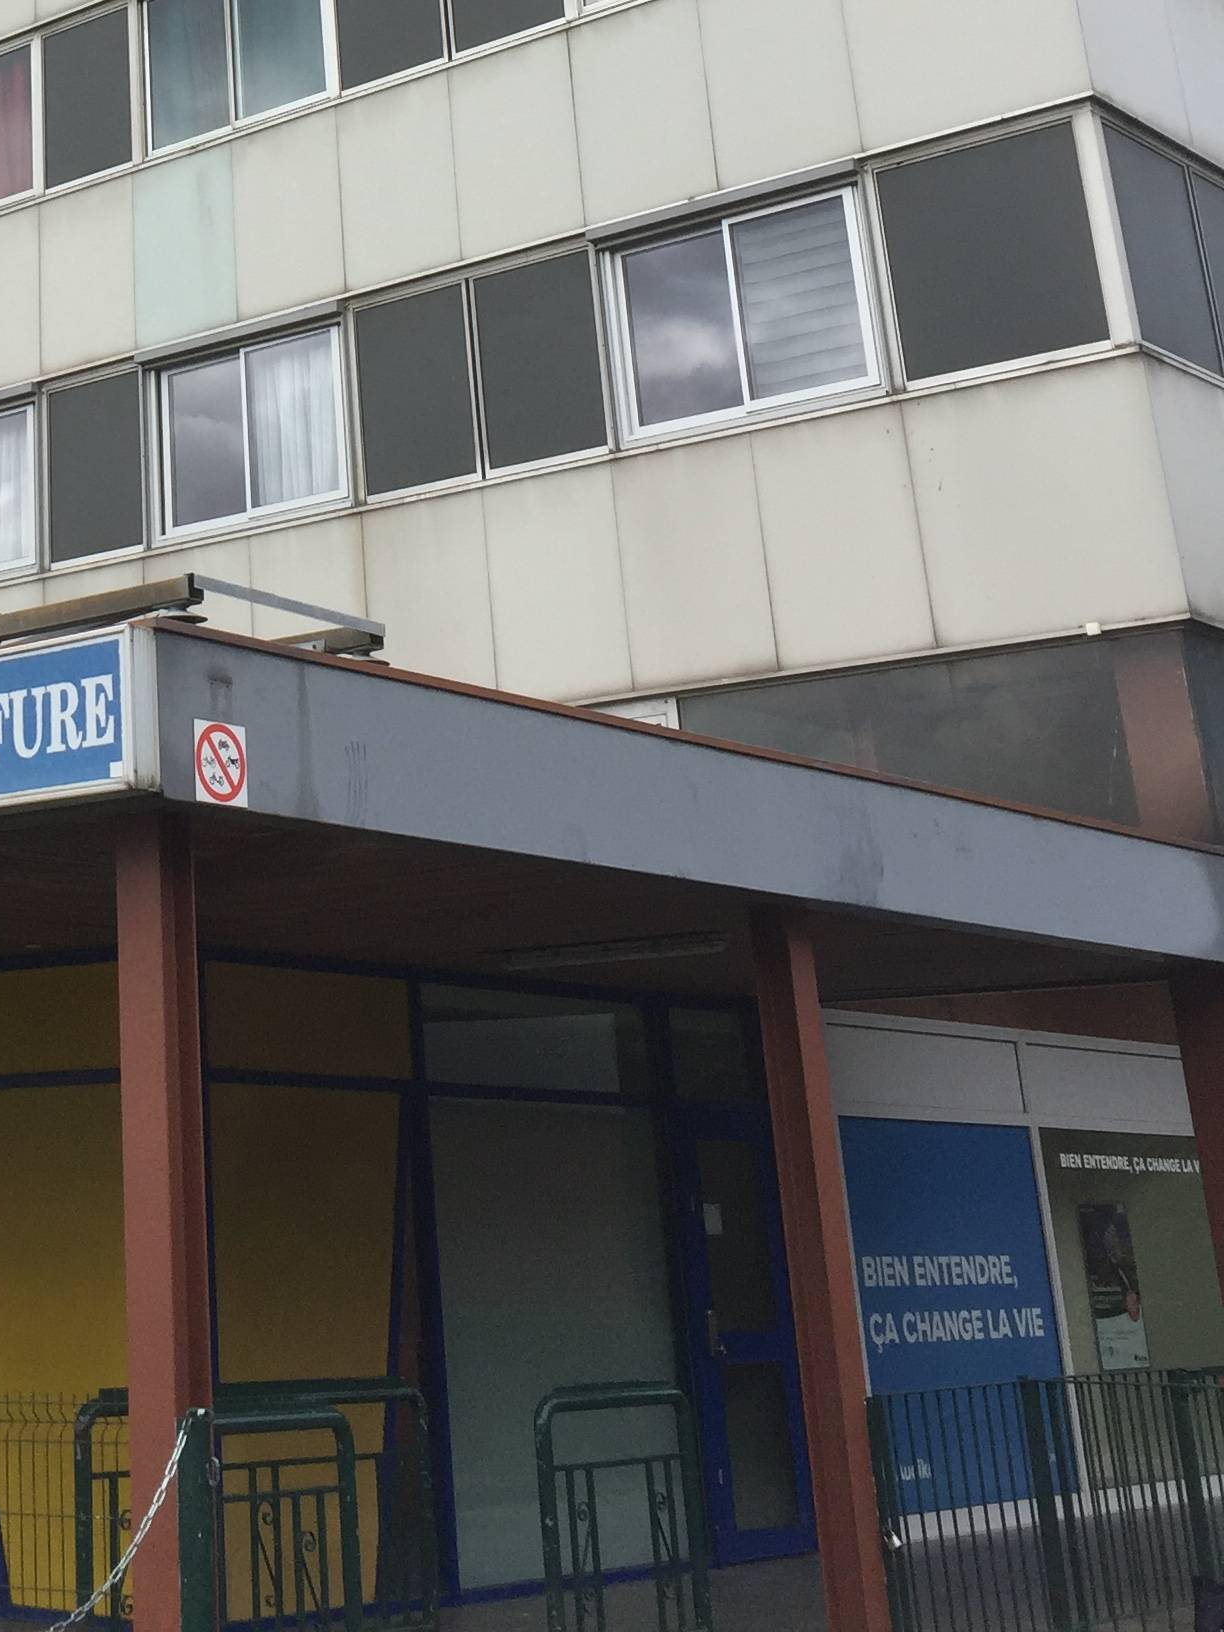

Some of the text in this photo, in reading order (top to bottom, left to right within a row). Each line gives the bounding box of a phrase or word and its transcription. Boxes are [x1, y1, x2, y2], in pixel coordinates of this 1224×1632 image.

[1059, 1153, 1082, 1169] BIEN
[1083, 1154, 1133, 1173] ENTENDRE,
[1133, 1157, 1146, 1174] ÇA
[1146, 1158, 1181, 1173] CHANGE
[1181, 1159, 1193, 1173] LA
[862, 1255, 1018, 1289] BIEN ENTENDRE,
[869, 1307, 1045, 1354] ÇA CHANGE LA VIE
